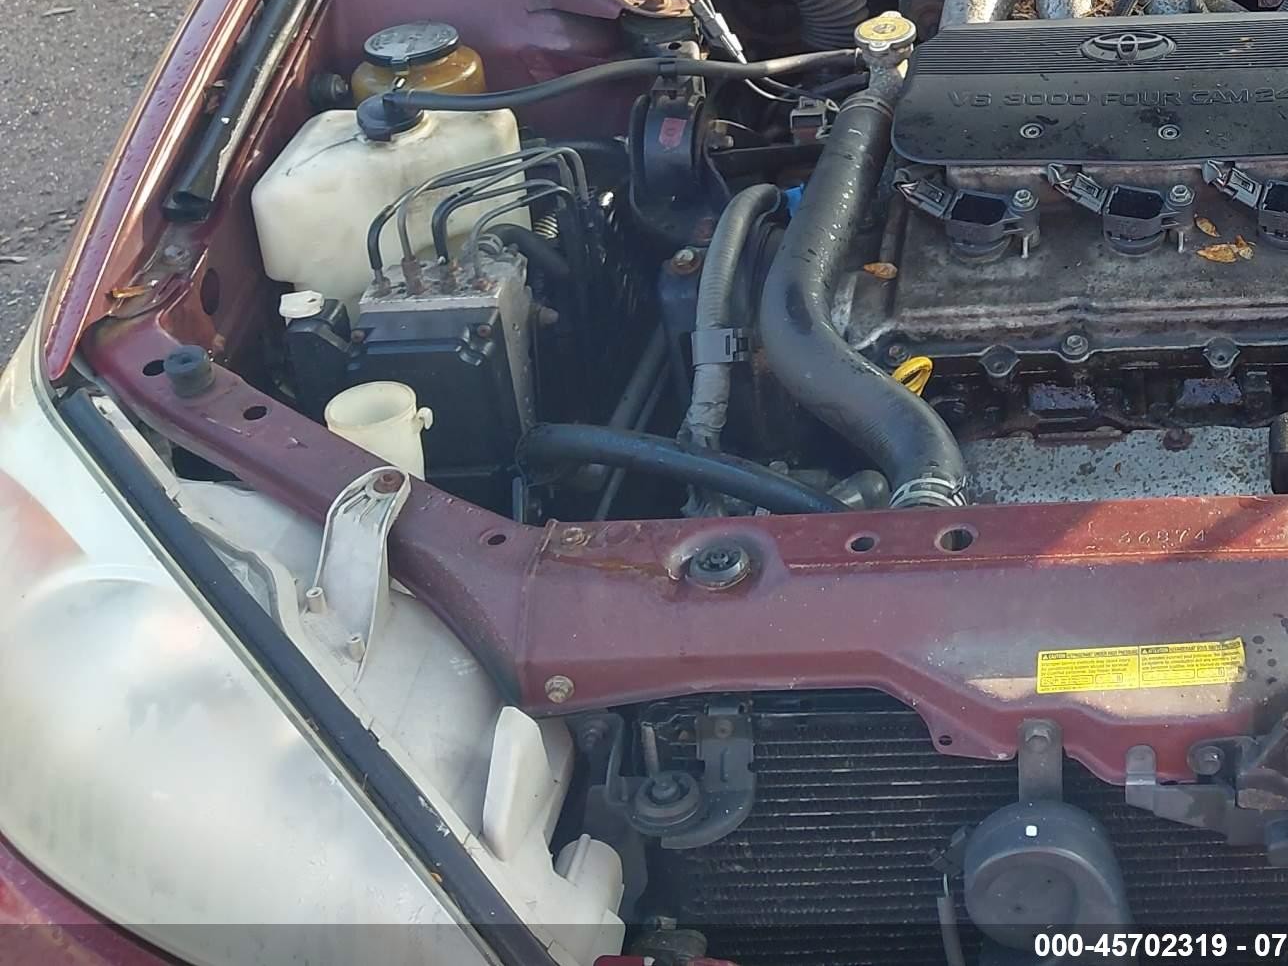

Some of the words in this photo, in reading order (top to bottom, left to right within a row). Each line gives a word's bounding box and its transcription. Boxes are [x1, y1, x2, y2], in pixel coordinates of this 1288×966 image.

[948, 90, 993, 108] V6
[1002, 90, 1090, 107] 3000
[1100, 90, 1183, 107] FOUR
